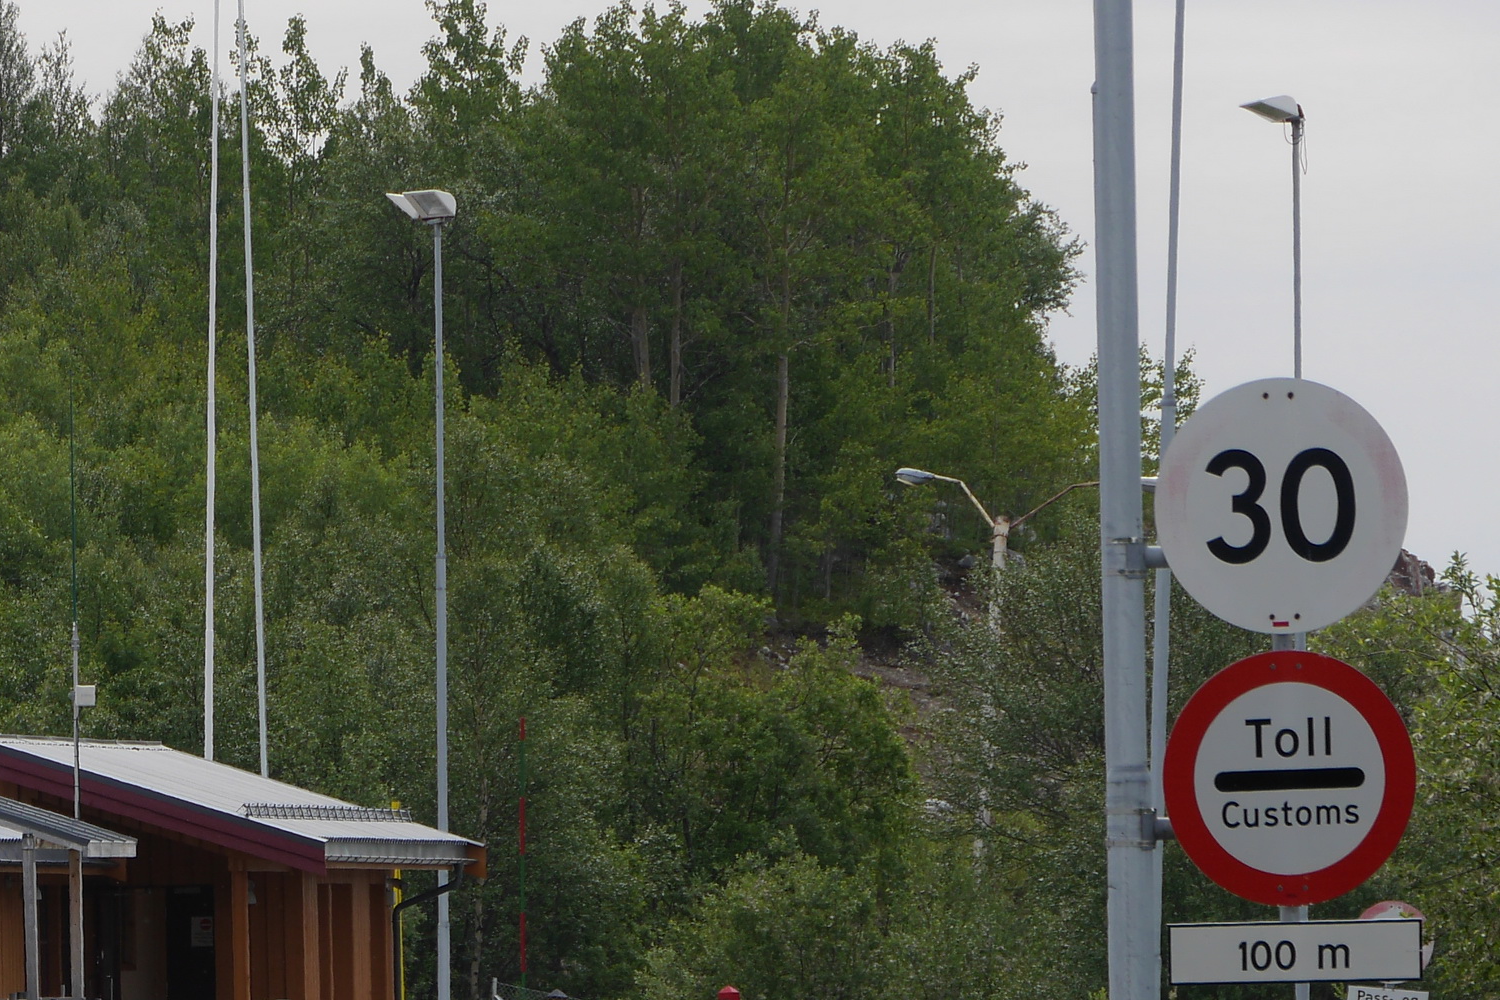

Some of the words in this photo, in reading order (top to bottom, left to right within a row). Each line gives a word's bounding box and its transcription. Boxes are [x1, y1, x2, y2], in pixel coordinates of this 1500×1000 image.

[1205, 447, 1356, 565] 30
[1244, 716, 1332, 758] Toll
[1221, 800, 1360, 829] Customs
[1238, 940, 1297, 972] 100
[1317, 943, 1350, 970] m
